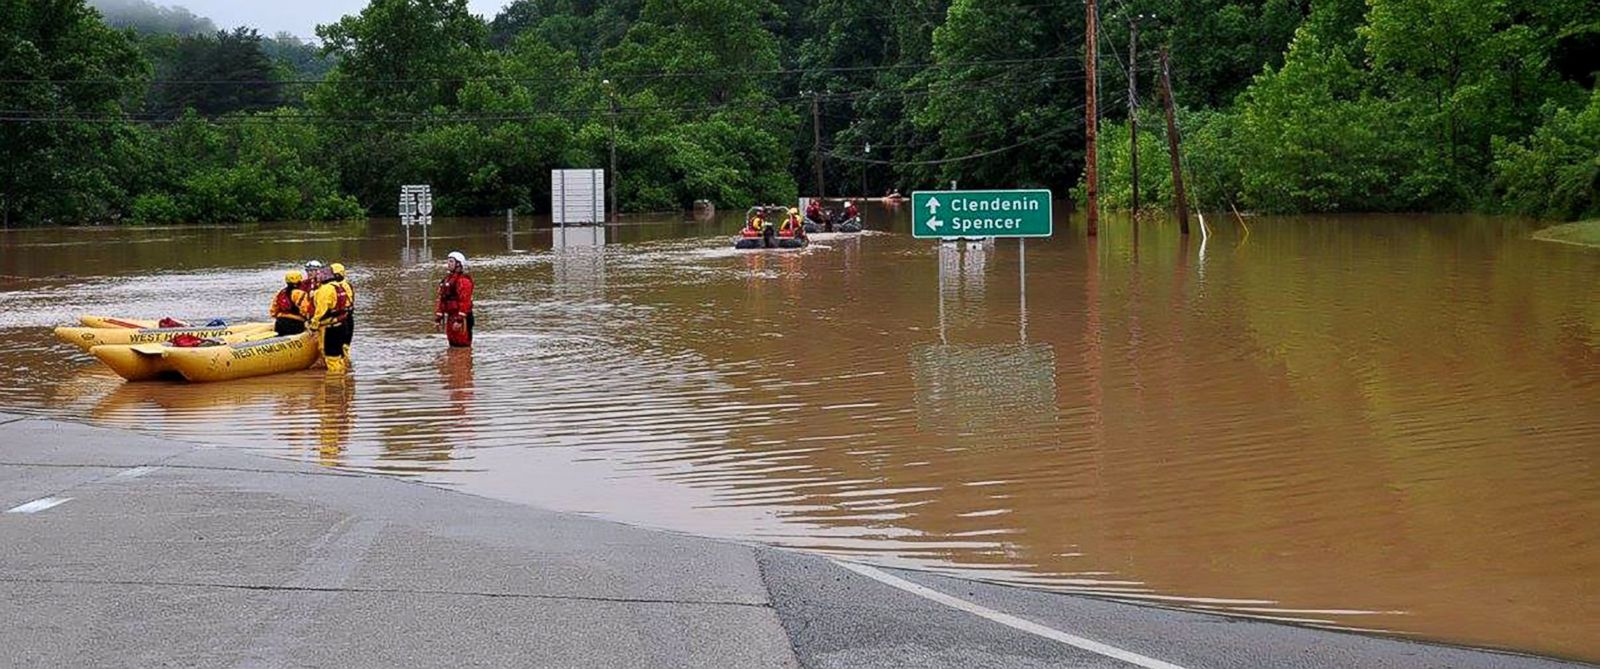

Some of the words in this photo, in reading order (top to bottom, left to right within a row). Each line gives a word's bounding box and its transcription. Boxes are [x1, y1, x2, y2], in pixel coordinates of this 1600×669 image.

[951, 197, 1039, 211] Clendenin
[952, 217, 1022, 232] Spencer
[130, 333, 161, 342] WEST
[163, 331, 208, 341] HIN
[231, 346, 256, 359] WEST
[256, 342, 287, 355] HAMLIN
[287, 339, 304, 350] VFD
